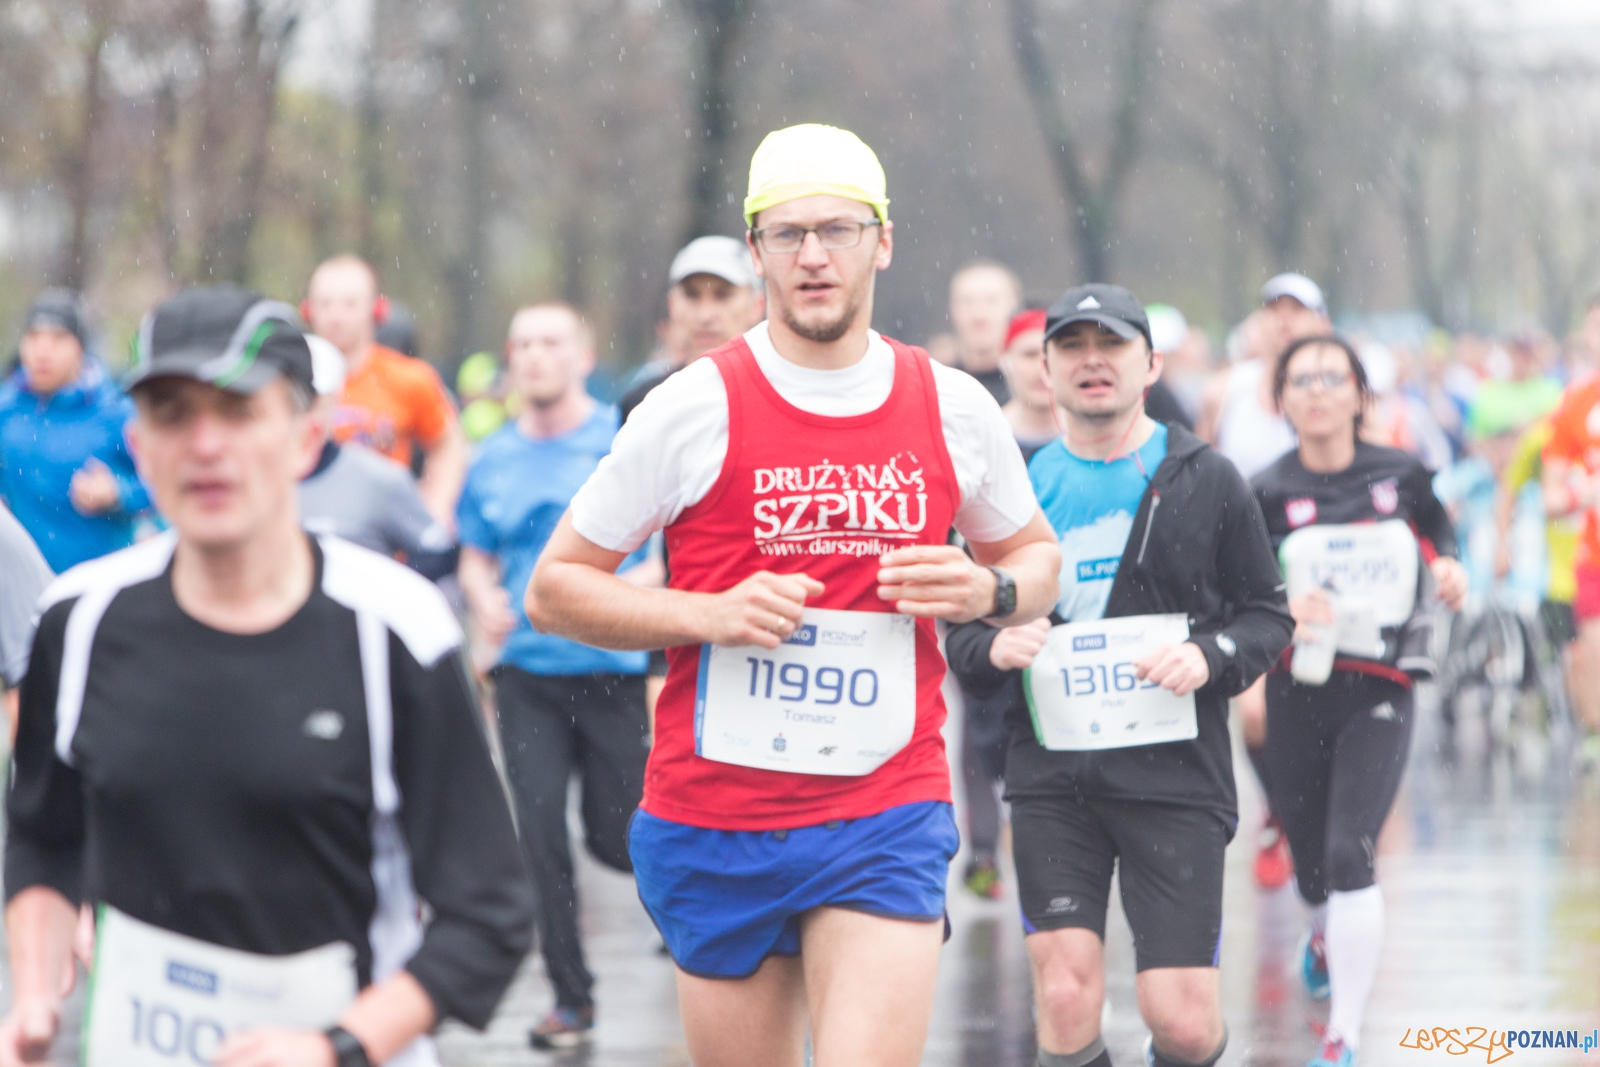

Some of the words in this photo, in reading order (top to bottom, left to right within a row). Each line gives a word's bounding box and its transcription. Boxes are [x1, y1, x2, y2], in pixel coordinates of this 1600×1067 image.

[753, 458, 900, 494] DRUŻYNA
[754, 489, 928, 540] SZPIKU
[759, 537, 917, 557] www.darszpiku
[747, 656, 879, 707] 11990
[1060, 662, 1161, 696] 1316
[784, 709, 837, 725] Tomasz
